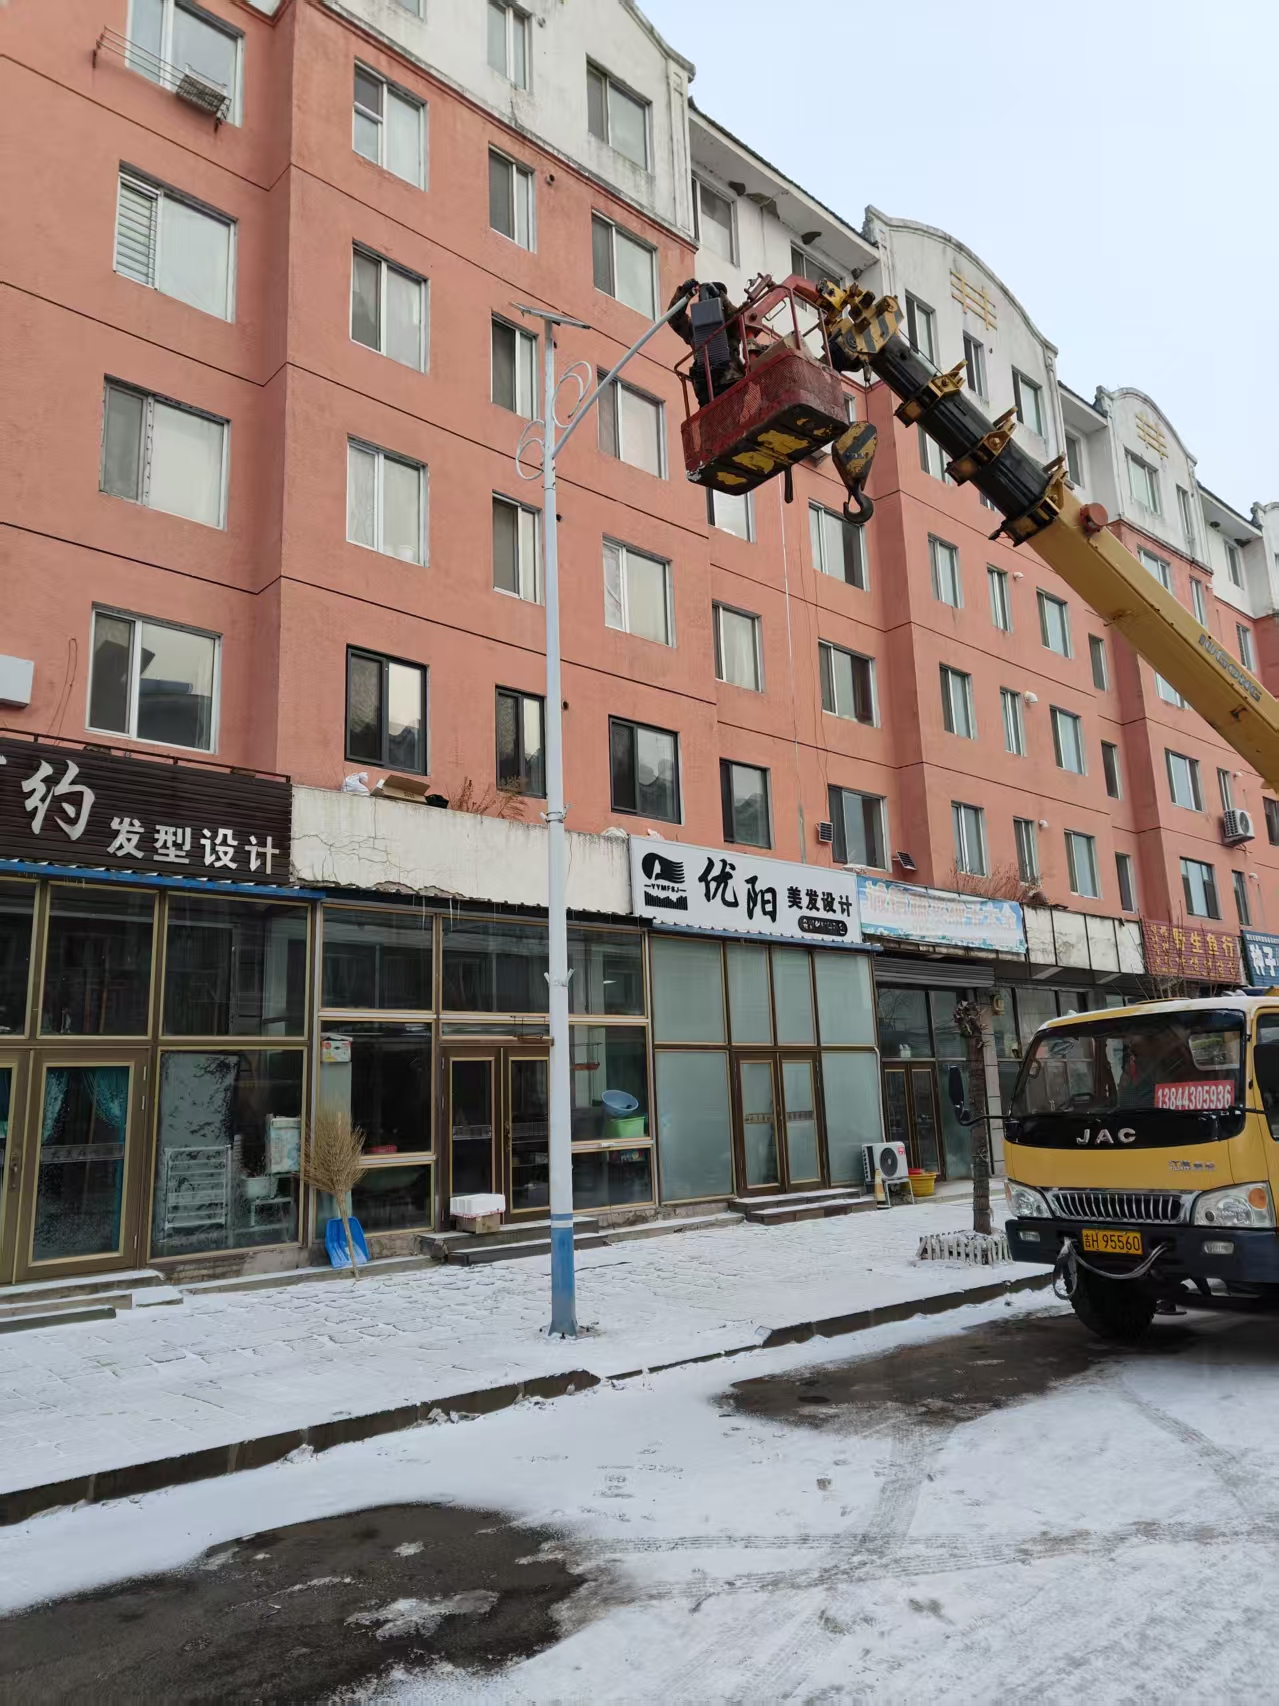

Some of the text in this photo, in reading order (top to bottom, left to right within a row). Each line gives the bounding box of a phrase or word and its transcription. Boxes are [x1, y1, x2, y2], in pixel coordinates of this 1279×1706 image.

[0, 755, 280, 875] 约 发型设计
[698, 856, 778, 923] 优阳
[786, 885, 853, 918] 美发设计
[1157, 1084, 1232, 1111] 13844305936
[1076, 1127, 1137, 1145] JAC
